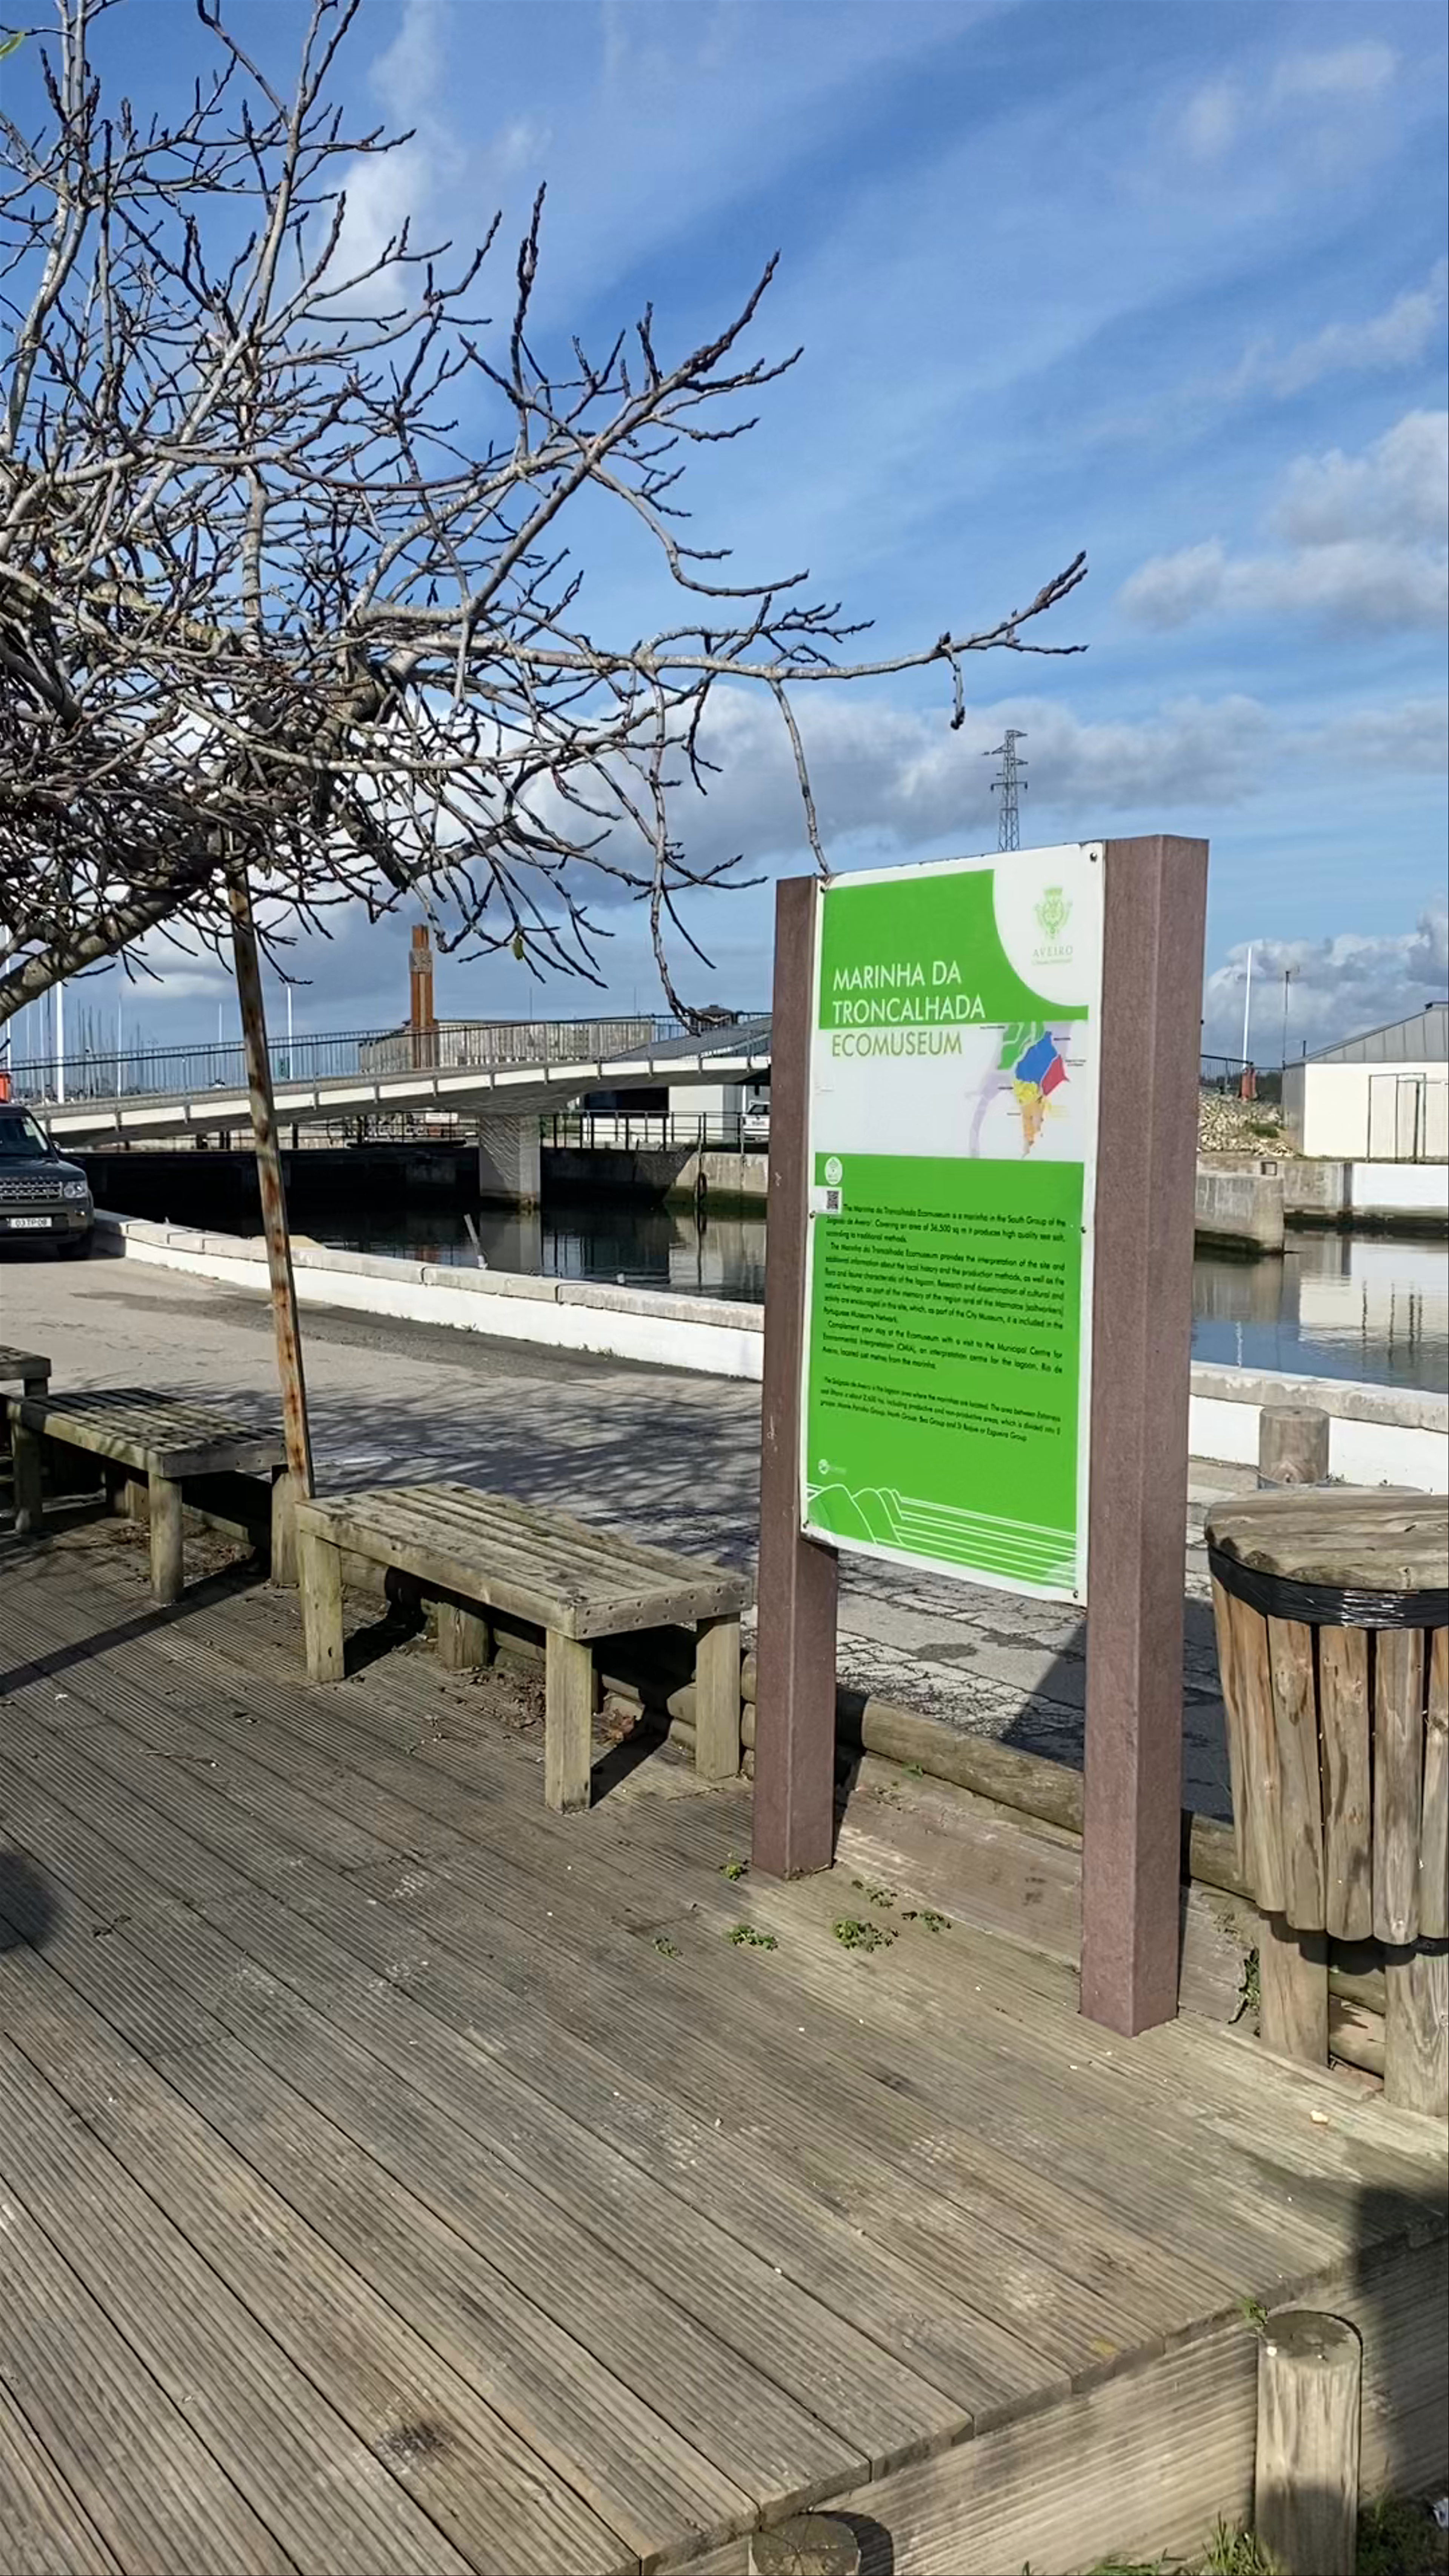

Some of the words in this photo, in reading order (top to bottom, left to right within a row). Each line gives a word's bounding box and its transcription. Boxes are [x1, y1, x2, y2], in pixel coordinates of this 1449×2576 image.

[1033, 945, 1073, 957] AVEIRO
[833, 963, 925, 992] MARINHA
[932, 961, 962, 985] DA
[832, 994, 986, 1024] TRONCALHADA
[832, 1031, 962, 1058] ECOMUSEUM
